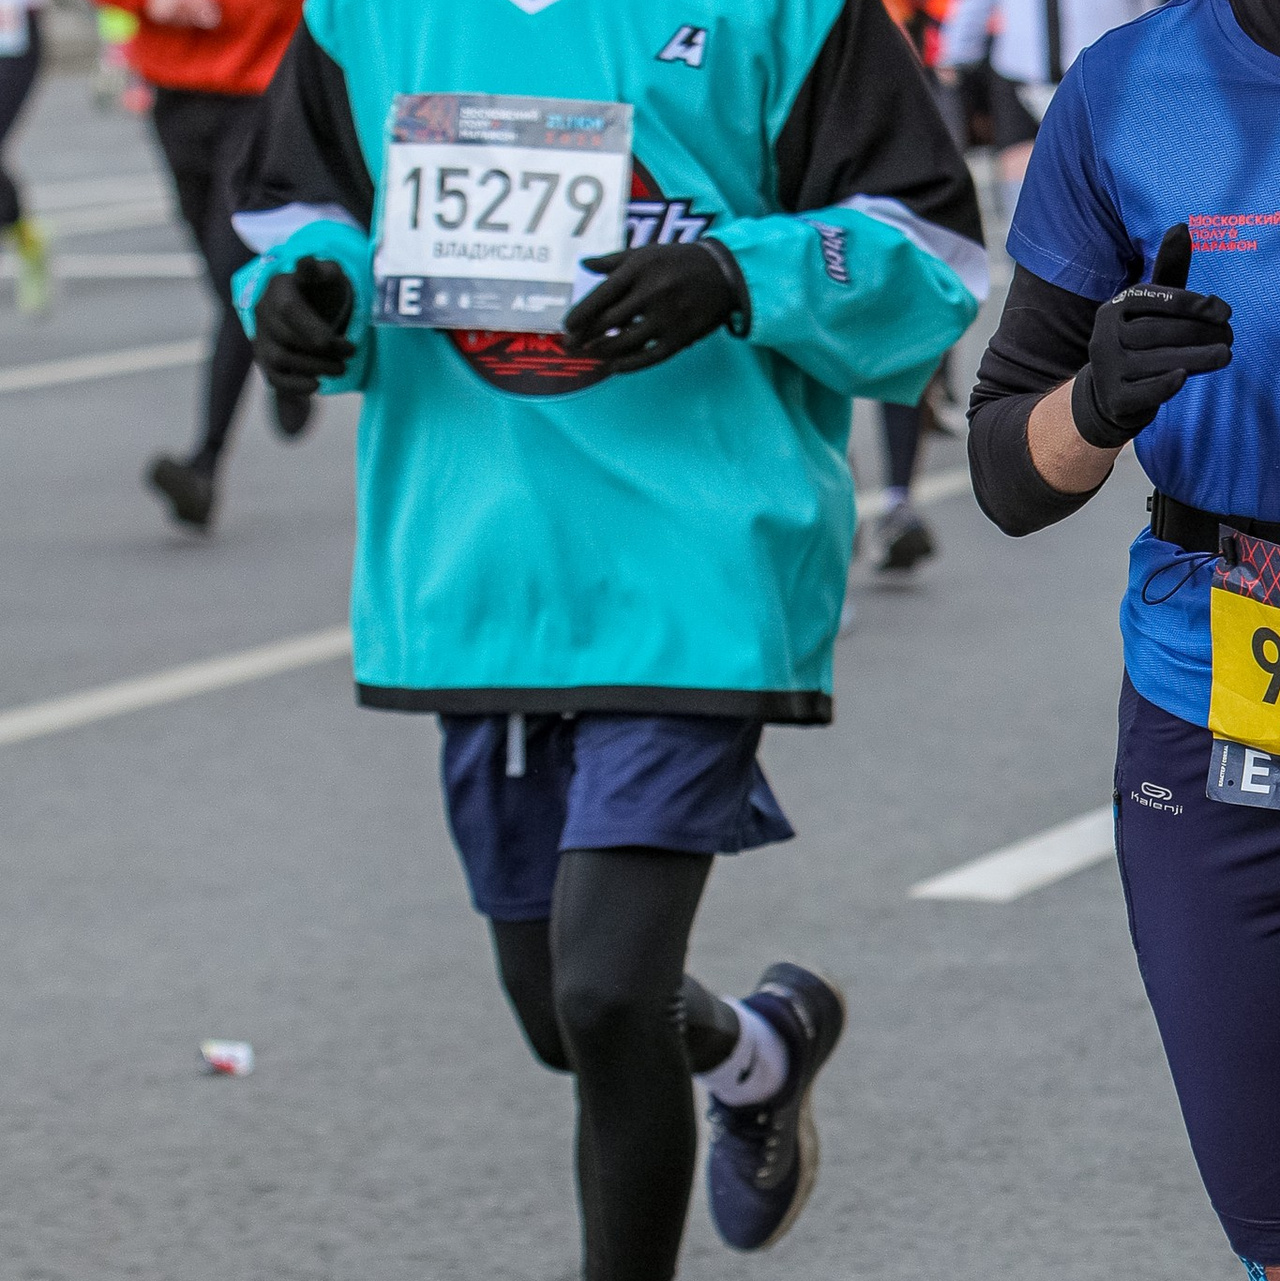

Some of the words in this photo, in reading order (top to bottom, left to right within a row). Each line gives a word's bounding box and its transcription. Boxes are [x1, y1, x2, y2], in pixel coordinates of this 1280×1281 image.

[403, 167, 604, 238] 15279
[1190, 228, 1227, 240] ПОЛУ
[1191, 239, 1258, 252] МАРАФОН
[433, 240, 551, 263] ВЛАДИСЛАВ
[399, 278, 423, 316] E
[1241, 748, 1271, 794] E
[1131, 791, 1183, 816] Kalenji
